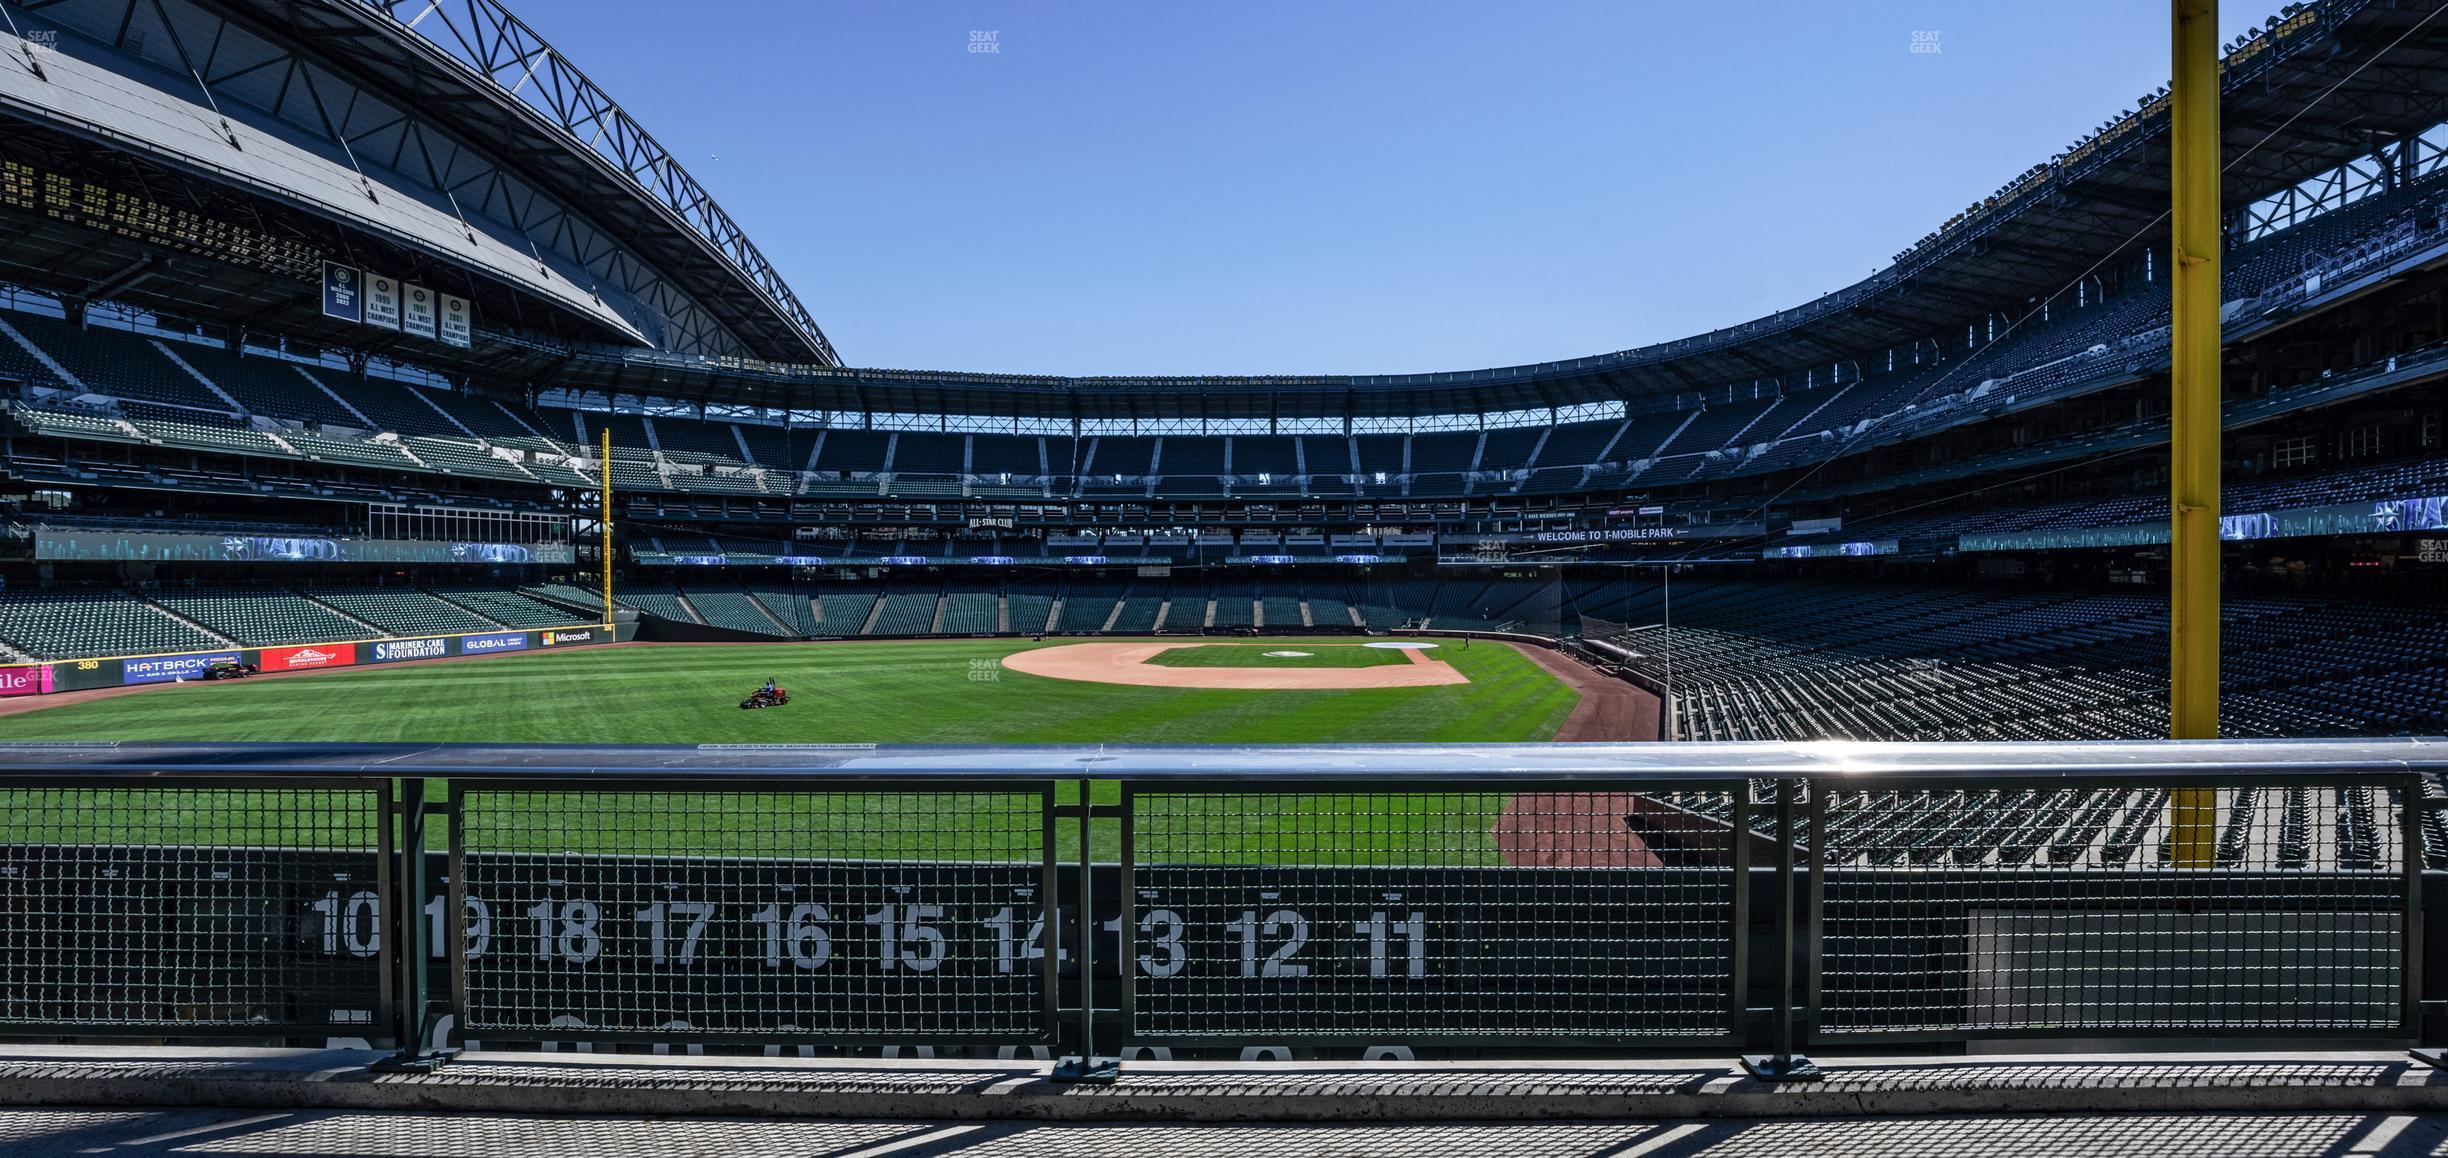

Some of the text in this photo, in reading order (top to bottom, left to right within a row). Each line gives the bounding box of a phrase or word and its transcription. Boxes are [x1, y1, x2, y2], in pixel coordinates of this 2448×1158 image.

[375, 293, 391, 305] 1995
[380, 305, 395, 316] WEST
[413, 303, 427, 314] 1997
[367, 311, 398, 325] CHAMPIONS
[417, 314, 432, 324] WEST
[405, 320, 434, 334] CHAMPIONS
[453, 323, 467, 333] WEST
[442, 329, 469, 342] CHAMPIONS
[997, 518, 1013, 529] CLUB
[1537, 528, 1675, 542] WELCOME TO T-MOBILE PARK
[556, 630, 591, 642] Microsoft
[389, 638, 445, 651] MARINERS CARE
[467, 639, 506, 649] GLOBAL
[389, 646, 445, 659] FOUNDATION
[77, 660, 99, 670] 380
[127, 658, 207, 673] HATBACK
[312, 890, 380, 958] 10
[424, 895, 490, 960] 19
[527, 898, 600, 963] 18
[635, 901, 715, 965] 17
[752, 902, 830, 970] 16
[865, 903, 946, 971] 15
[983, 906, 1067, 973] 14
[1226, 910, 1308, 977] 12
[1355, 911, 1424, 980] 11
